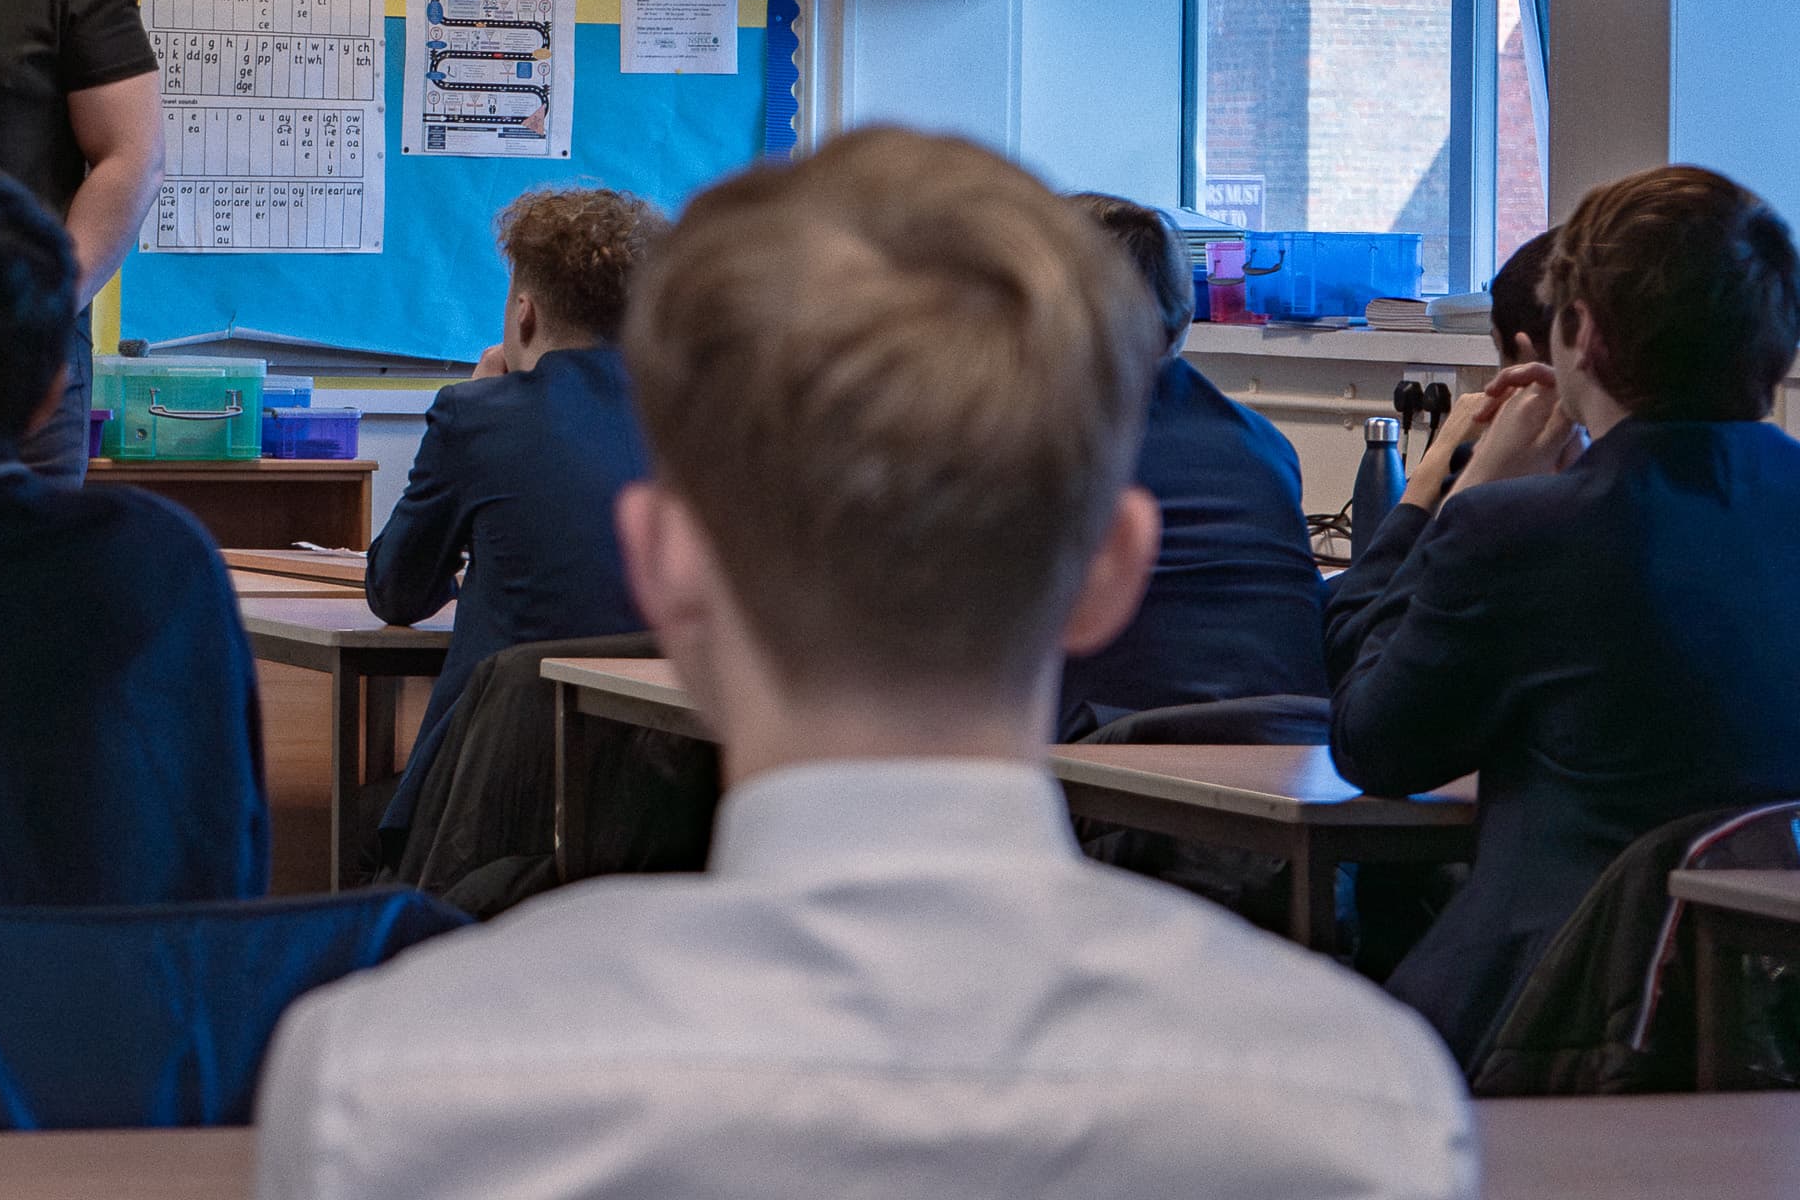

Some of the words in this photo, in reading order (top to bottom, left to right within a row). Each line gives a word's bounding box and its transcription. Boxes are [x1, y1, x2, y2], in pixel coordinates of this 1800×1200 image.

[276, 43, 288, 52] qu
[358, 42, 369, 52] ch
[187, 50, 200, 60] dd
[204, 54, 217, 64] gg
[258, 56, 271, 65] pp
[295, 56, 302, 64] tt
[308, 55, 321, 64] wh
[357, 56, 371, 66] tch
[169, 64, 181, 73] ck
[240, 69, 252, 78] ge
[169, 78, 180, 88] ch
[236, 80, 252, 92] dge
[279, 115, 290, 124] ay
[323, 113, 338, 124] igh
[235, 186, 248, 194] air
[292, 188, 304, 197] oy
[347, 186, 363, 196] ure
[1225, 183, 1261, 205] MUST
